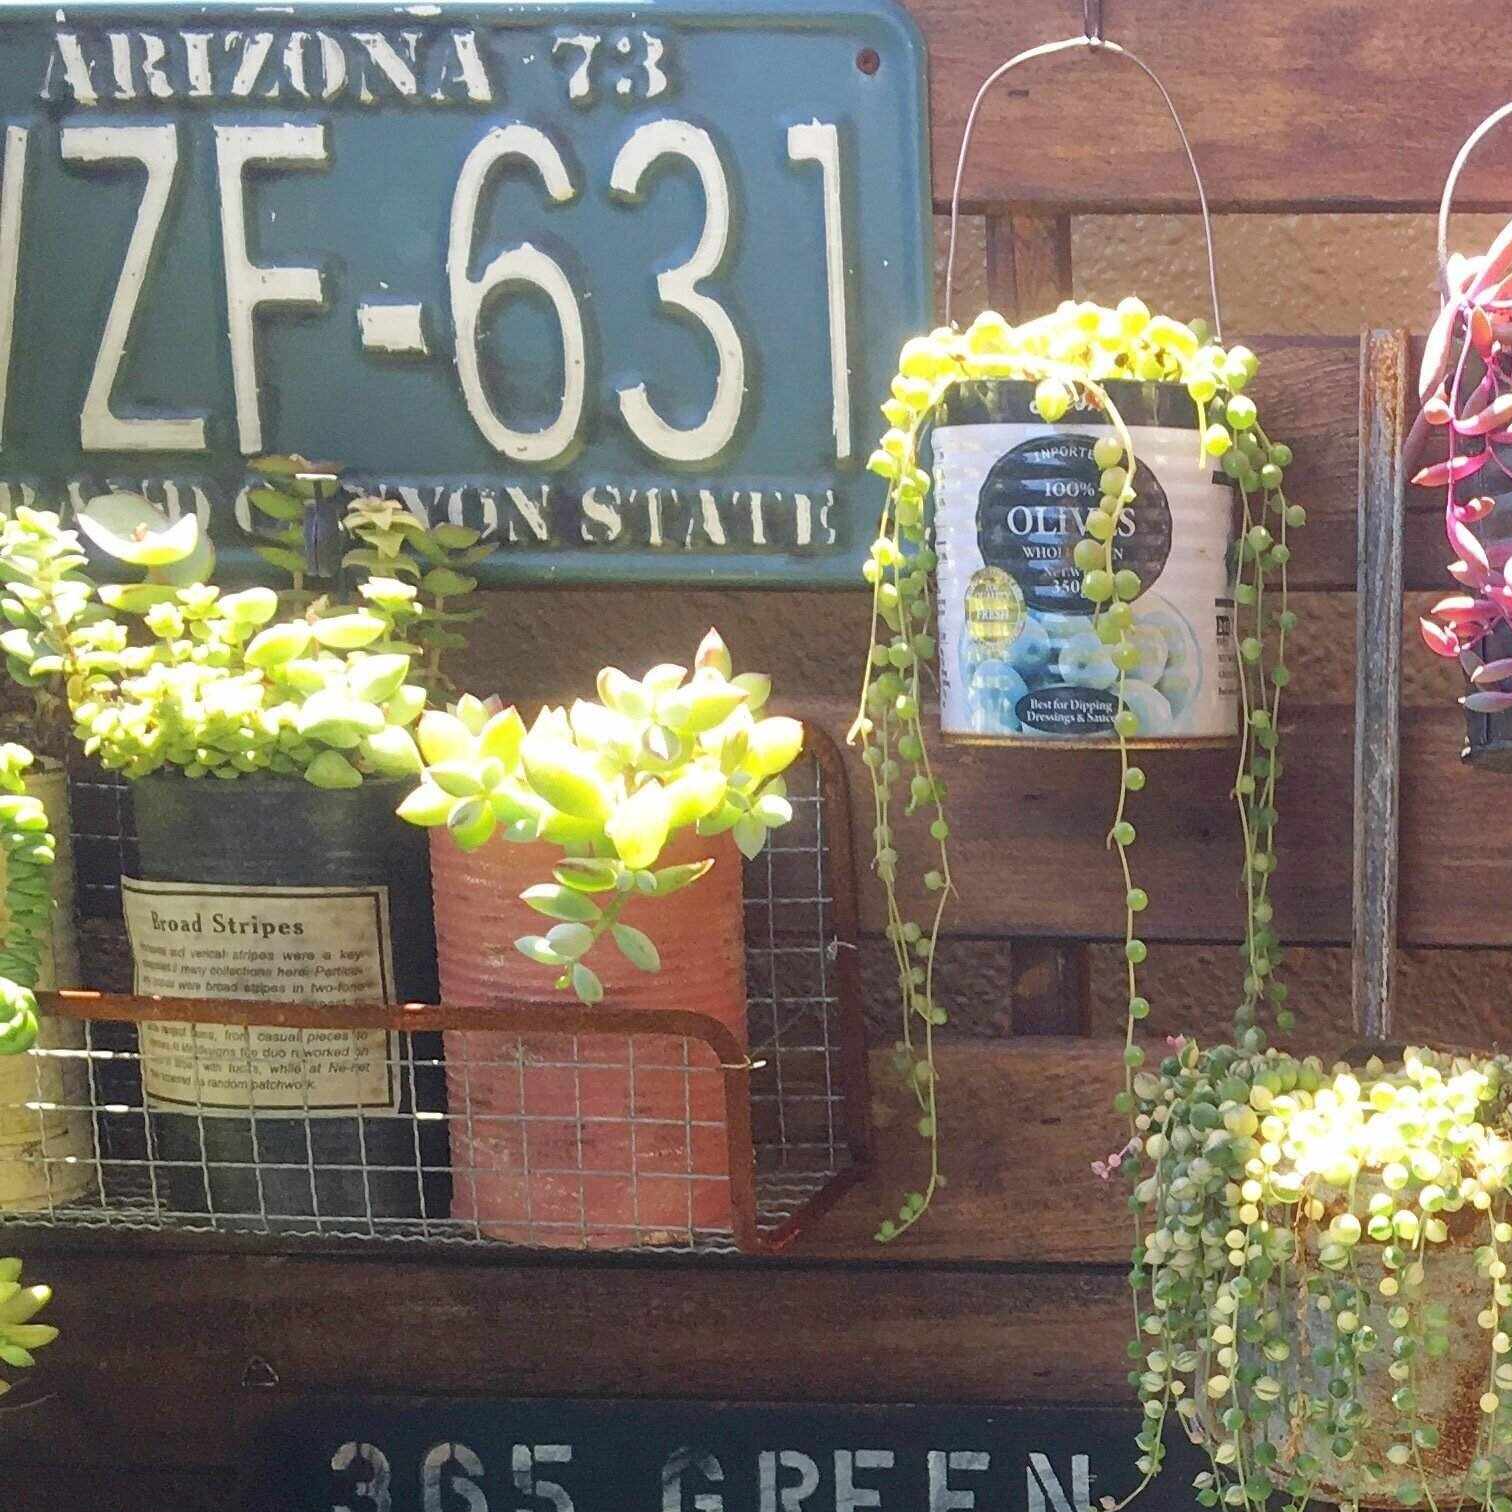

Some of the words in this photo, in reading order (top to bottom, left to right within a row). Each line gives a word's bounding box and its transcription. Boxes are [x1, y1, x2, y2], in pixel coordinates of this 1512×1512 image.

[40, 31, 492, 104] ARIZONA
[553, 31, 669, 99] 73
[1045, 481, 1095, 497] 100%
[582, 484, 835, 550] STATE
[1007, 505, 1136, 537] OLiVS
[1030, 698, 1052, 710] Best
[1053, 698, 1069, 710] for
[1070, 699, 1113, 714] Dipping
[151, 910, 202, 933] Broad
[212, 912, 305, 938] Stripes
